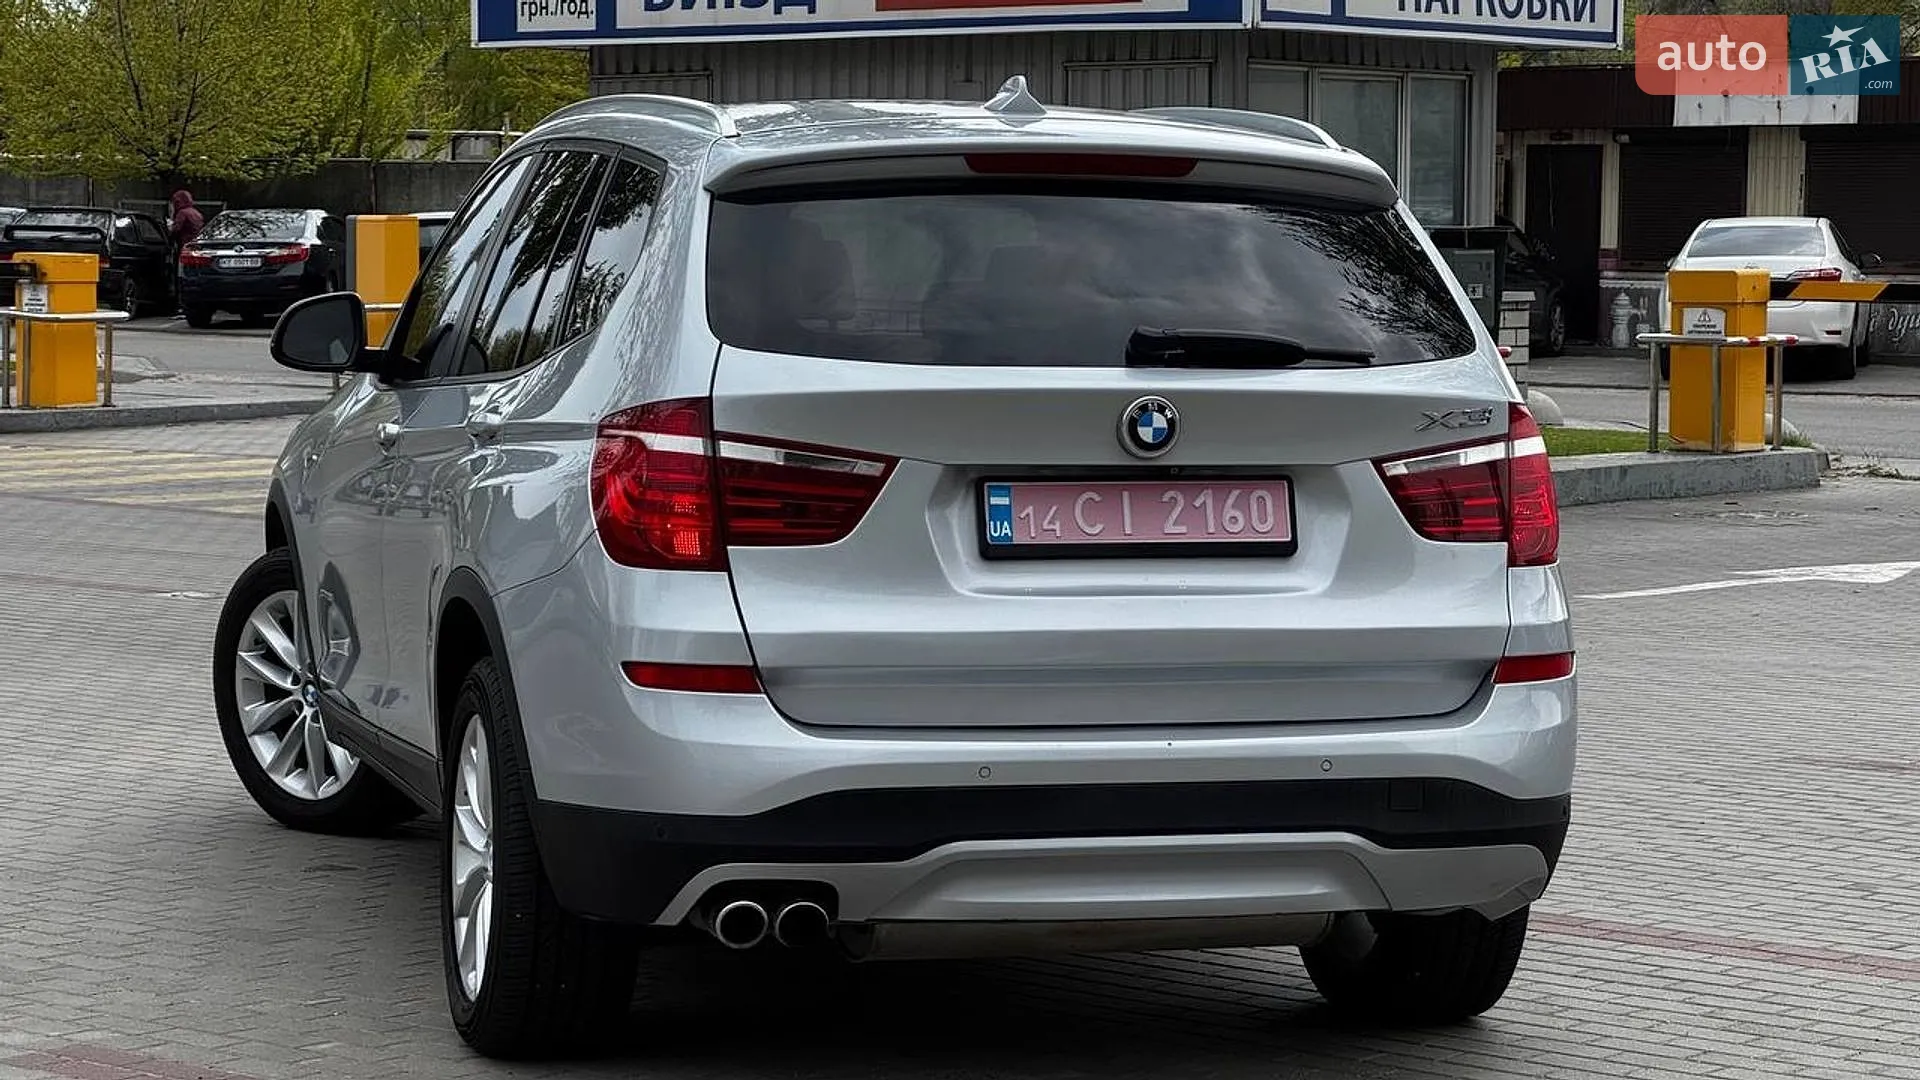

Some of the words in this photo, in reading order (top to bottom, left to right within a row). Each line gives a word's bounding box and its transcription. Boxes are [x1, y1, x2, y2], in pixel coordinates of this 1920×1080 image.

[520, 0, 594, 22] грн./год.
[1397, 0, 1596, 23] ОВКИ
[1415, 406, 1494, 432] X3
[1018, 505, 1062, 539] 14
[1160, 488, 1275, 535] 2160
[990, 520, 1012, 537] UA
